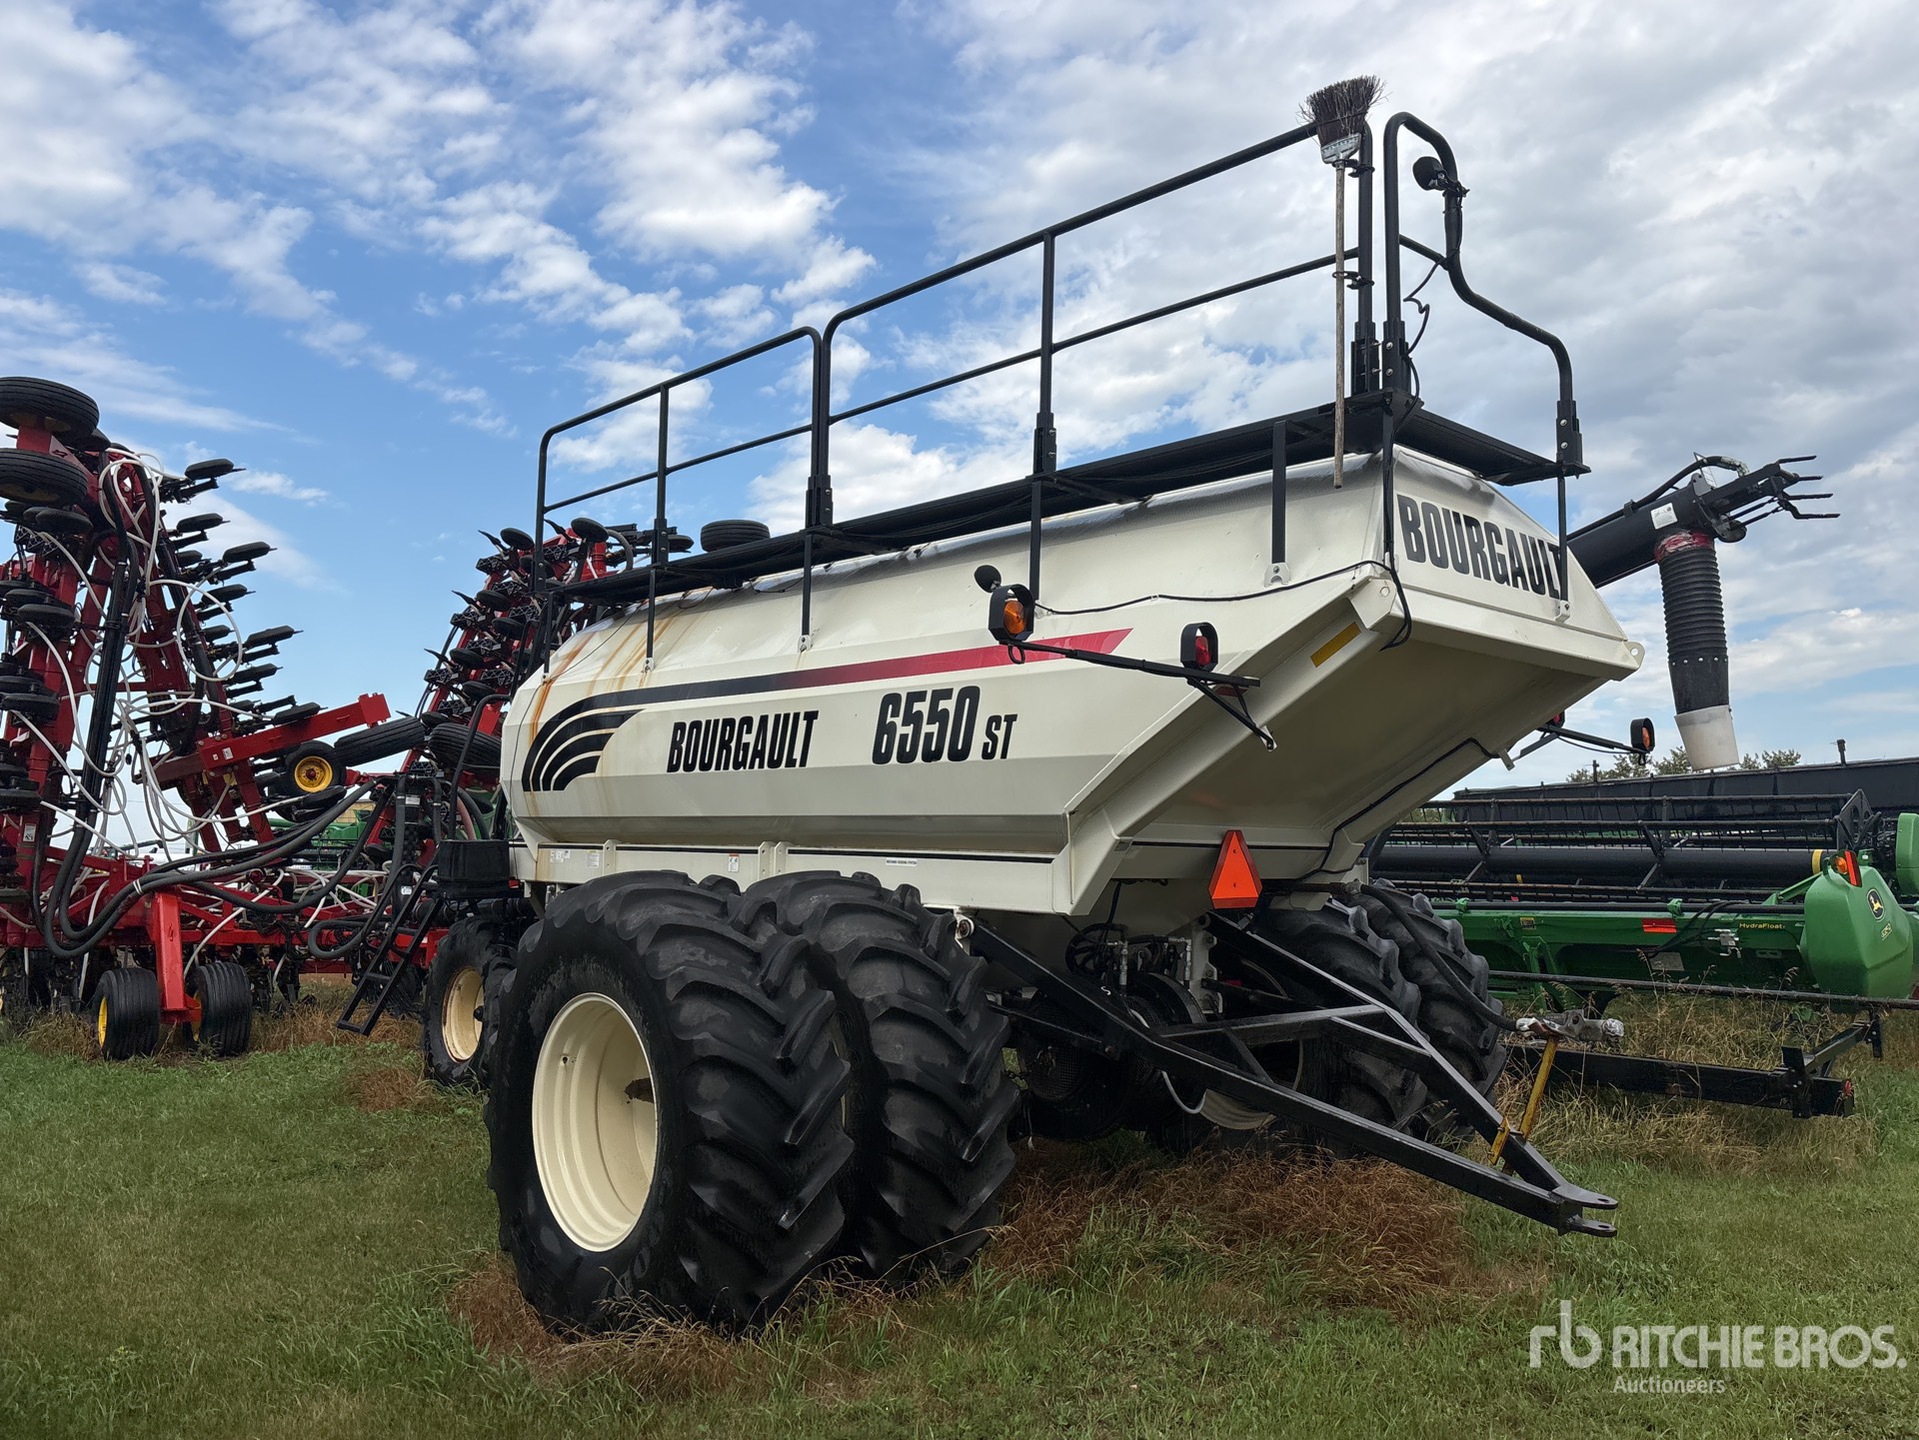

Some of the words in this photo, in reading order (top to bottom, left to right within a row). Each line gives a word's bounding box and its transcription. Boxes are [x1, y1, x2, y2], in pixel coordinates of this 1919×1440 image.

[1397, 494, 1562, 600] BOURGAULT
[667, 710, 819, 773] BOURGAULT
[872, 685, 980, 765] 6550
[981, 714, 1018, 760] ST
